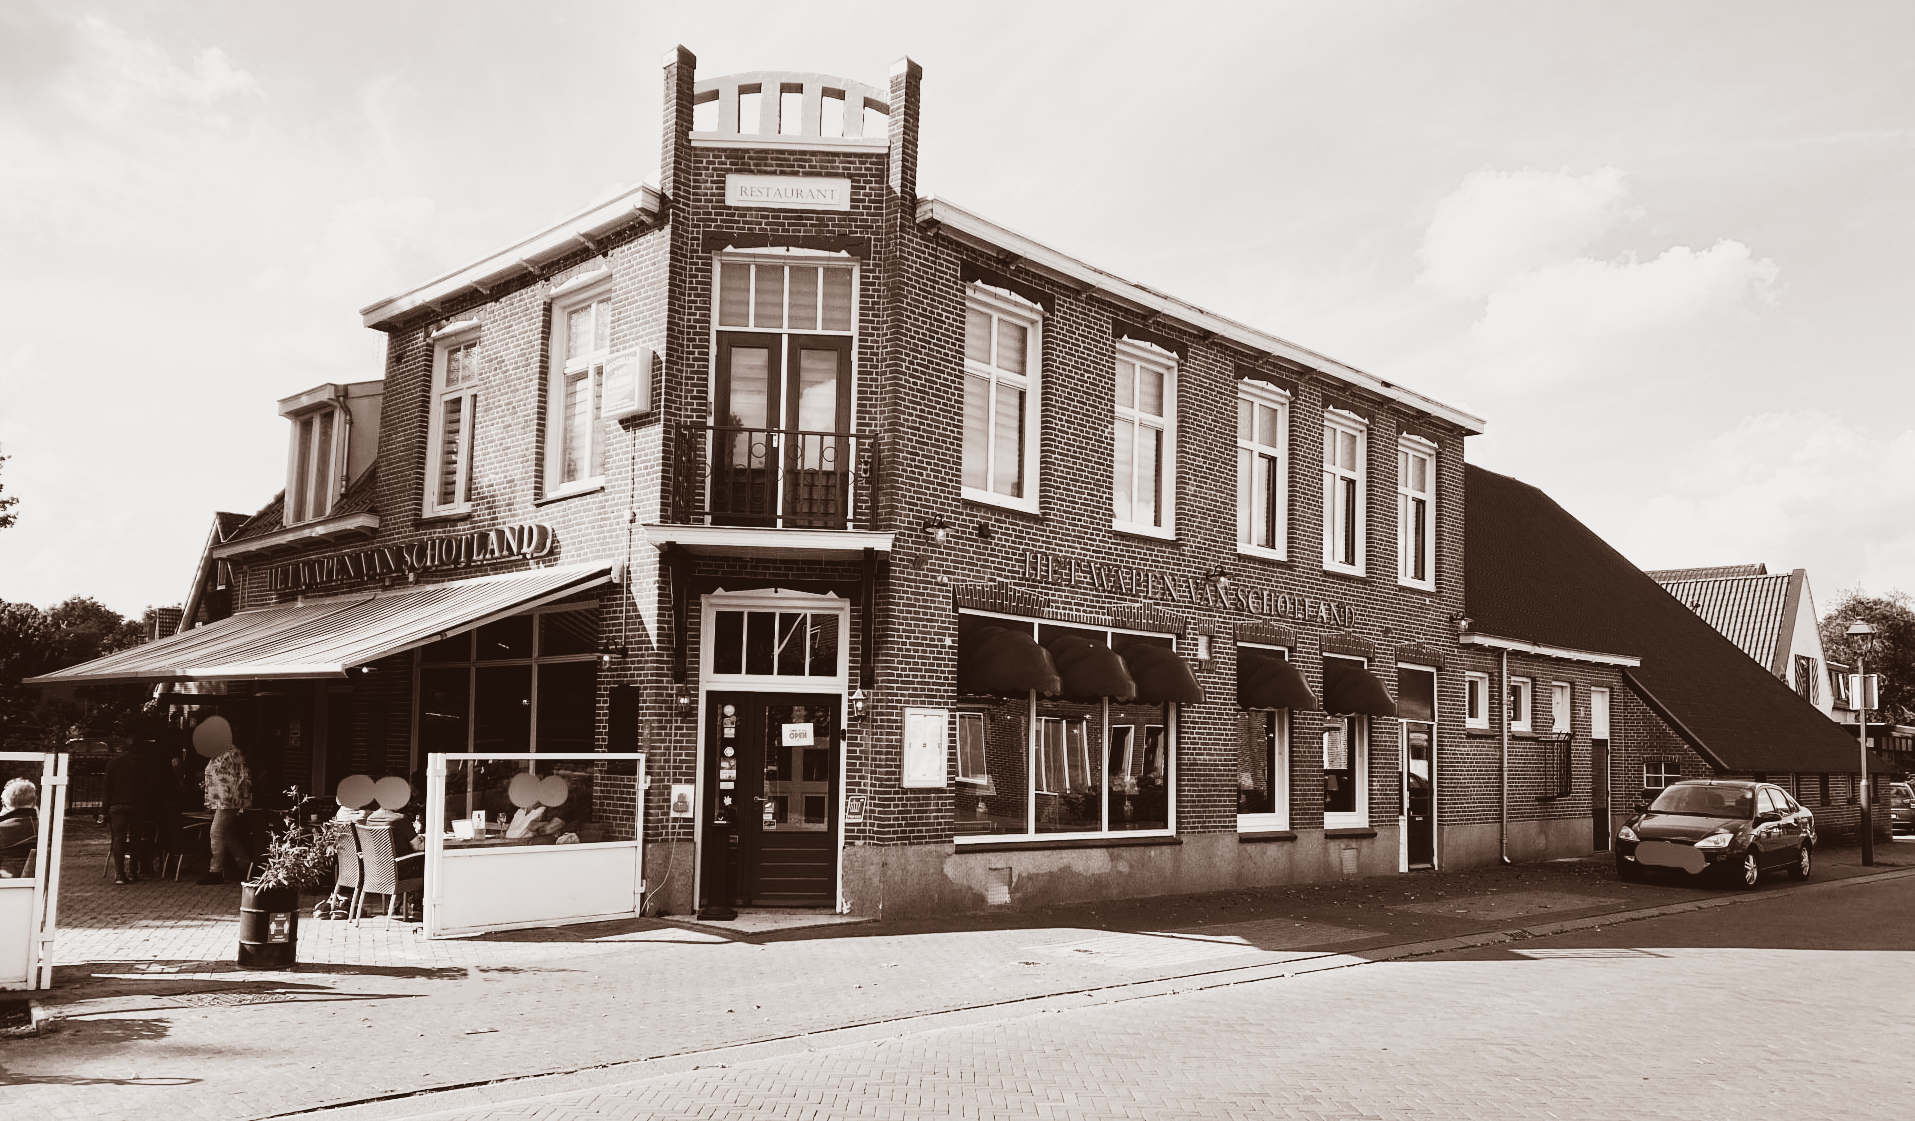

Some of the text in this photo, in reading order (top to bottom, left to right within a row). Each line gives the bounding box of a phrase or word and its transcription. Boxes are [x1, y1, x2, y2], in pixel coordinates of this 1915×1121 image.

[740, 185, 838, 200] RESTAURANT
[400, 524, 553, 574] SCHOTLAND
[1025, 551, 1356, 628] HET WAPEN VAN SCHOTLAND
